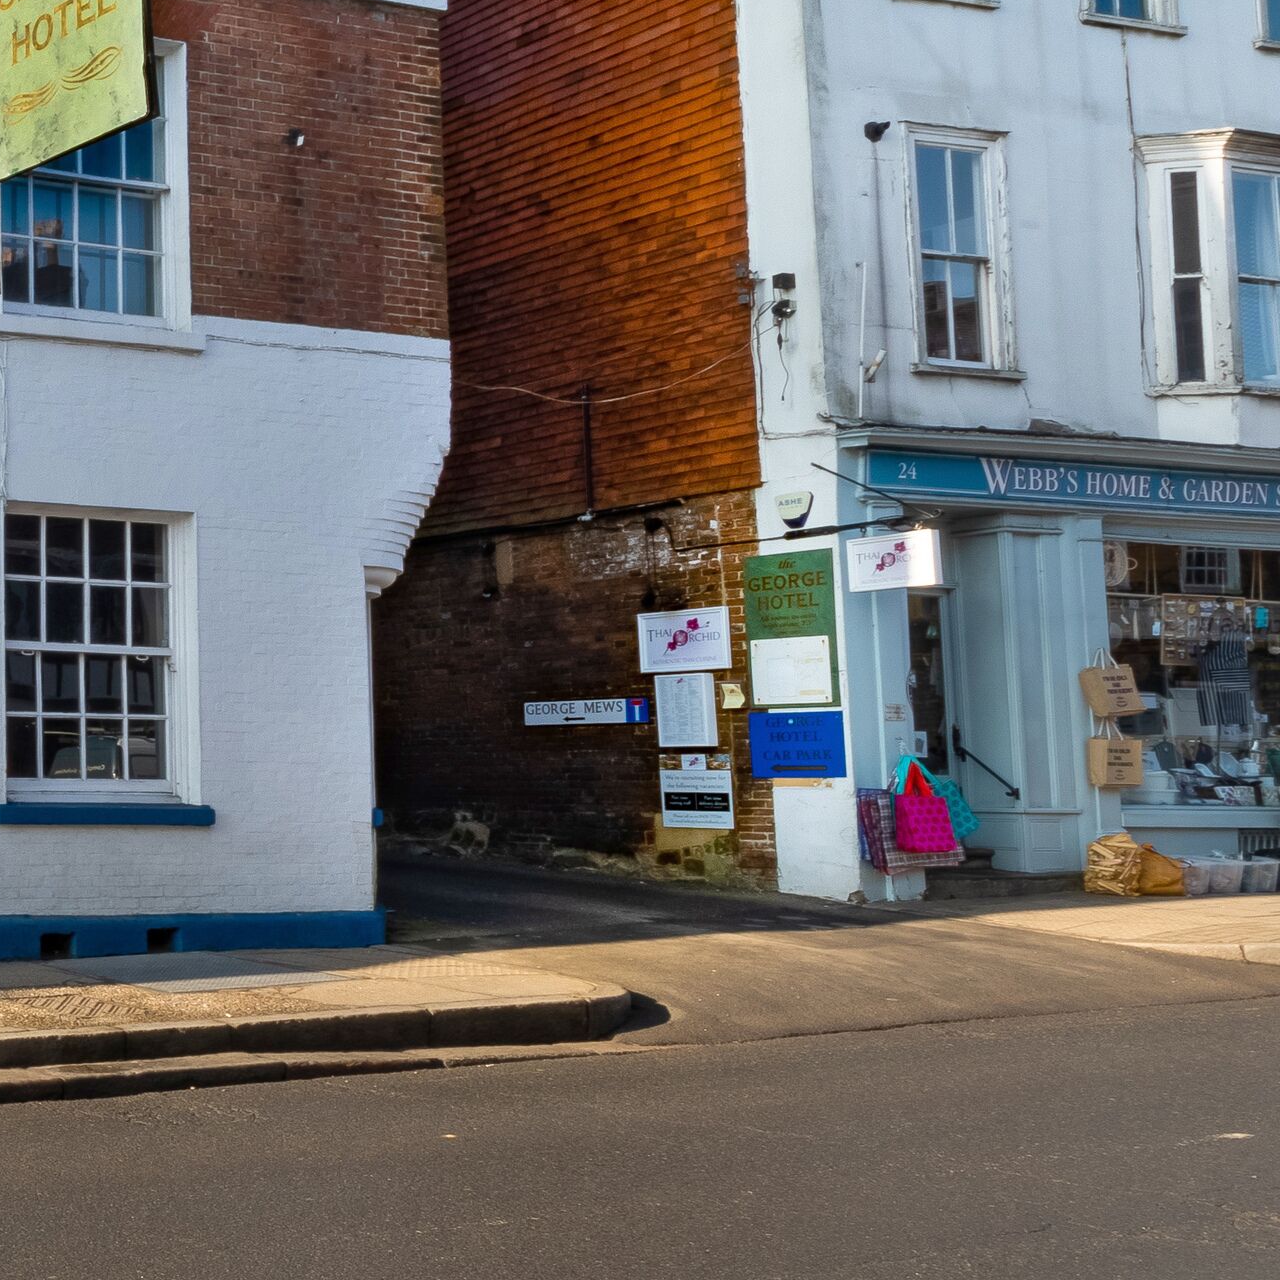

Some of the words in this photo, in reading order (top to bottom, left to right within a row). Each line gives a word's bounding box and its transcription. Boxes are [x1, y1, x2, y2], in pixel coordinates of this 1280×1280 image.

[897, 461, 917, 480] 24
[979, 457, 1079, 496] WEBB'S
[1086, 472, 1150, 498] HOME
[1158, 476, 1175, 499] &
[1183, 478, 1269, 505] GARDEN
[778, 497, 803, 506] ASHE
[778, 557, 796, 569] the
[747, 570, 828, 593] GEORGE
[756, 592, 820, 611] HOTEL
[647, 628, 672, 642] THAI
[673, 629, 721, 646] ORCHID
[525, 702, 576, 716] GEORGE
[583, 701, 624, 715] MEWS
[765, 715, 824, 728] GEORGE
[769, 730, 823, 742] HOTEL
[762, 750, 792, 761] CAR
[796, 750, 833, 760] PARK
